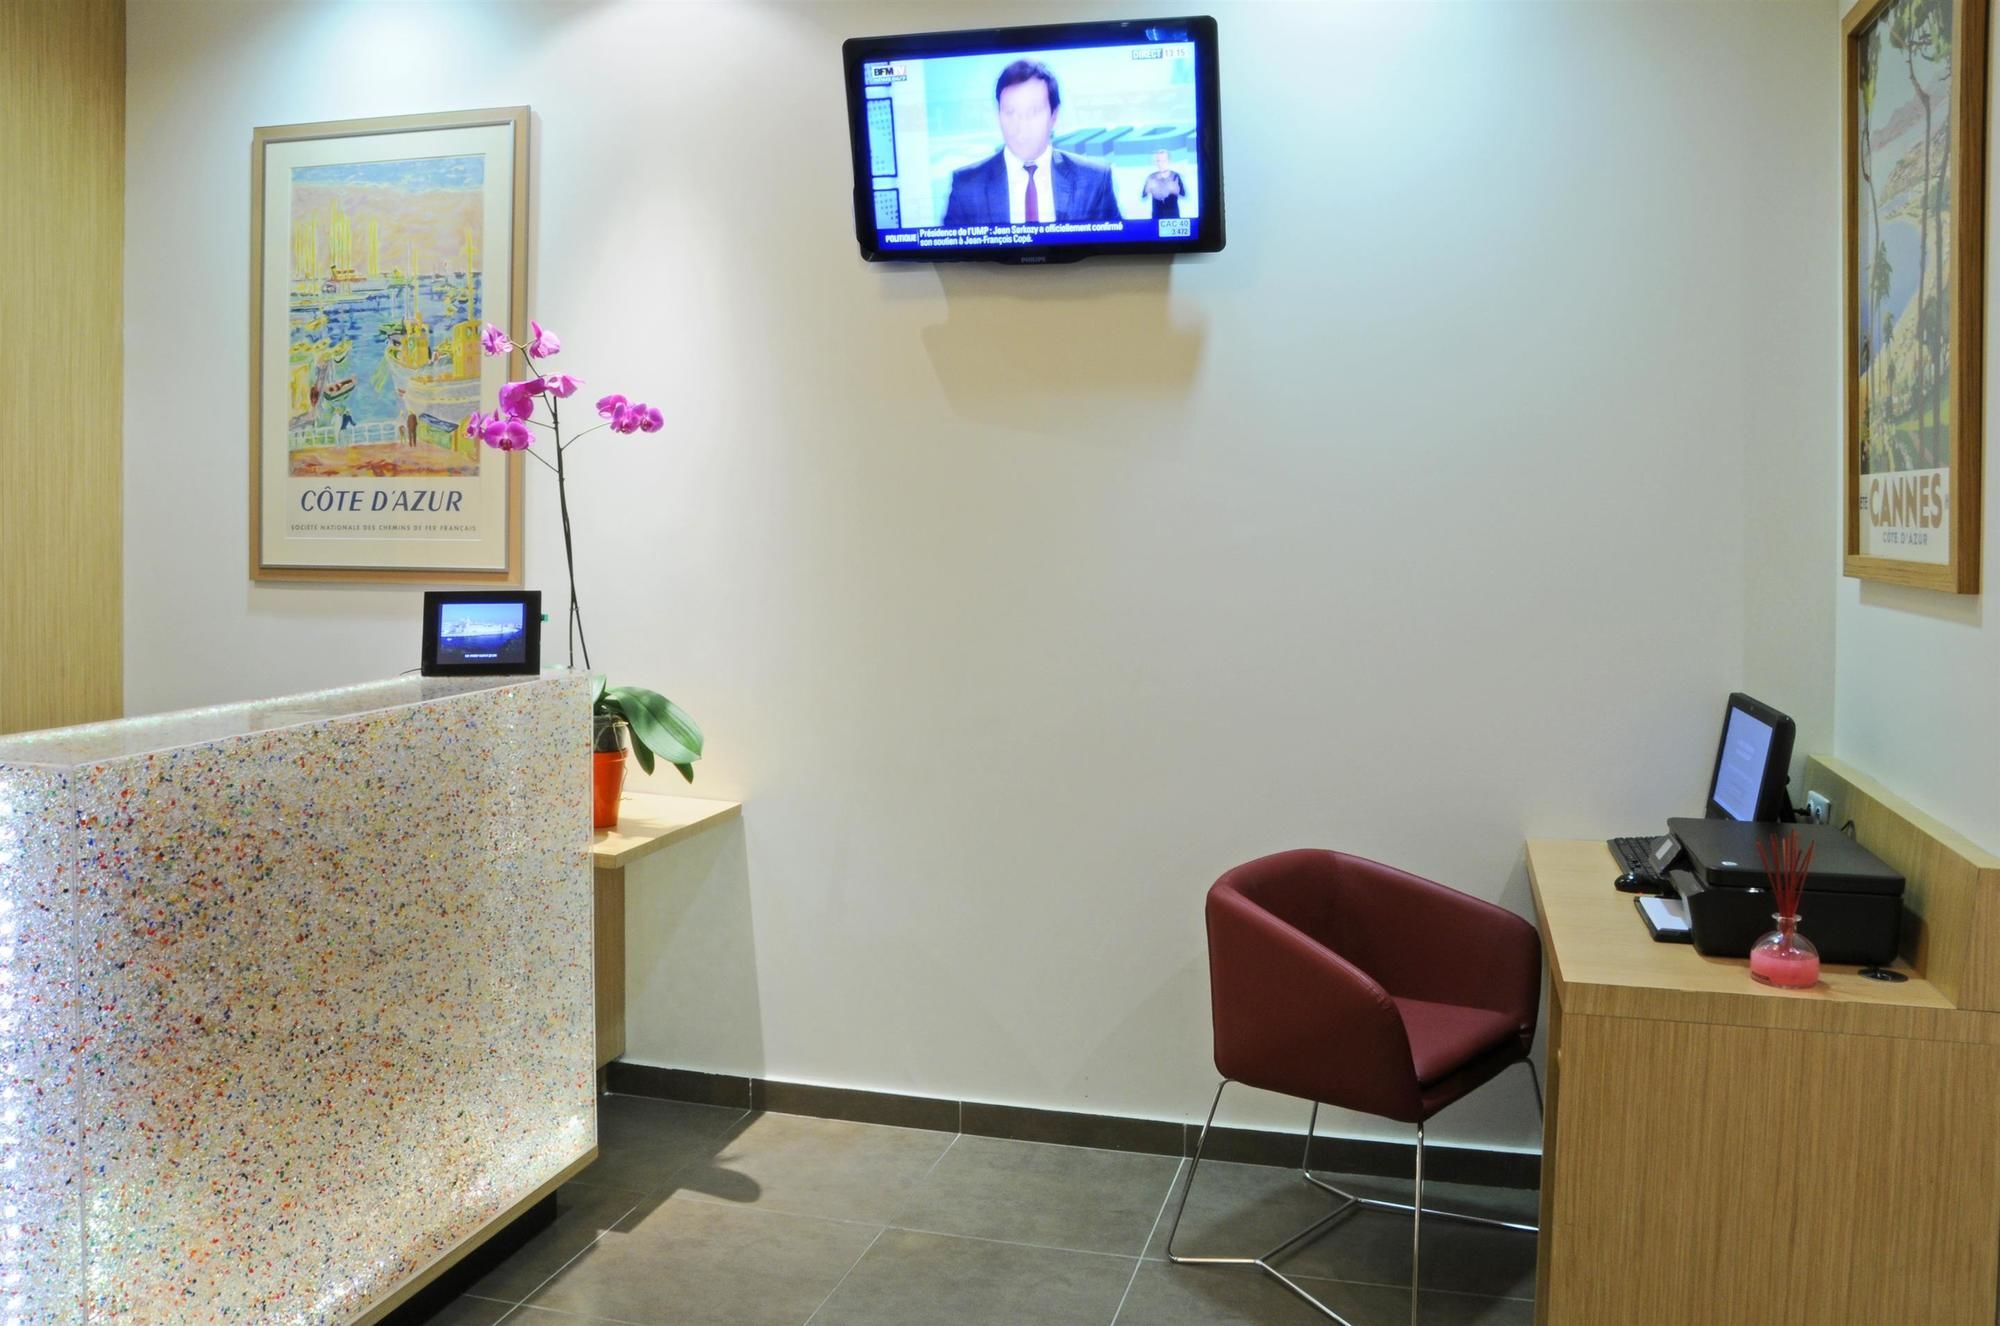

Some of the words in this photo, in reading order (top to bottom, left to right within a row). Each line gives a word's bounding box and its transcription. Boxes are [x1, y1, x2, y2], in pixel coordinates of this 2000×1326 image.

[919, 228, 957, 238] Présidence
[958, 227, 967, 236] de
[1045, 223, 1091, 232] officiellement
[1091, 222, 1123, 231] confirmé
[1160, 220, 1178, 228] CAC
[885, 233, 917, 243] POLITIQUE
[920, 239, 933, 247] son
[934, 238, 958, 246] soutien
[301, 486, 365, 512] CÔTE
[371, 490, 463, 512] D'AZUR
[1870, 473, 1943, 529] CANNES
